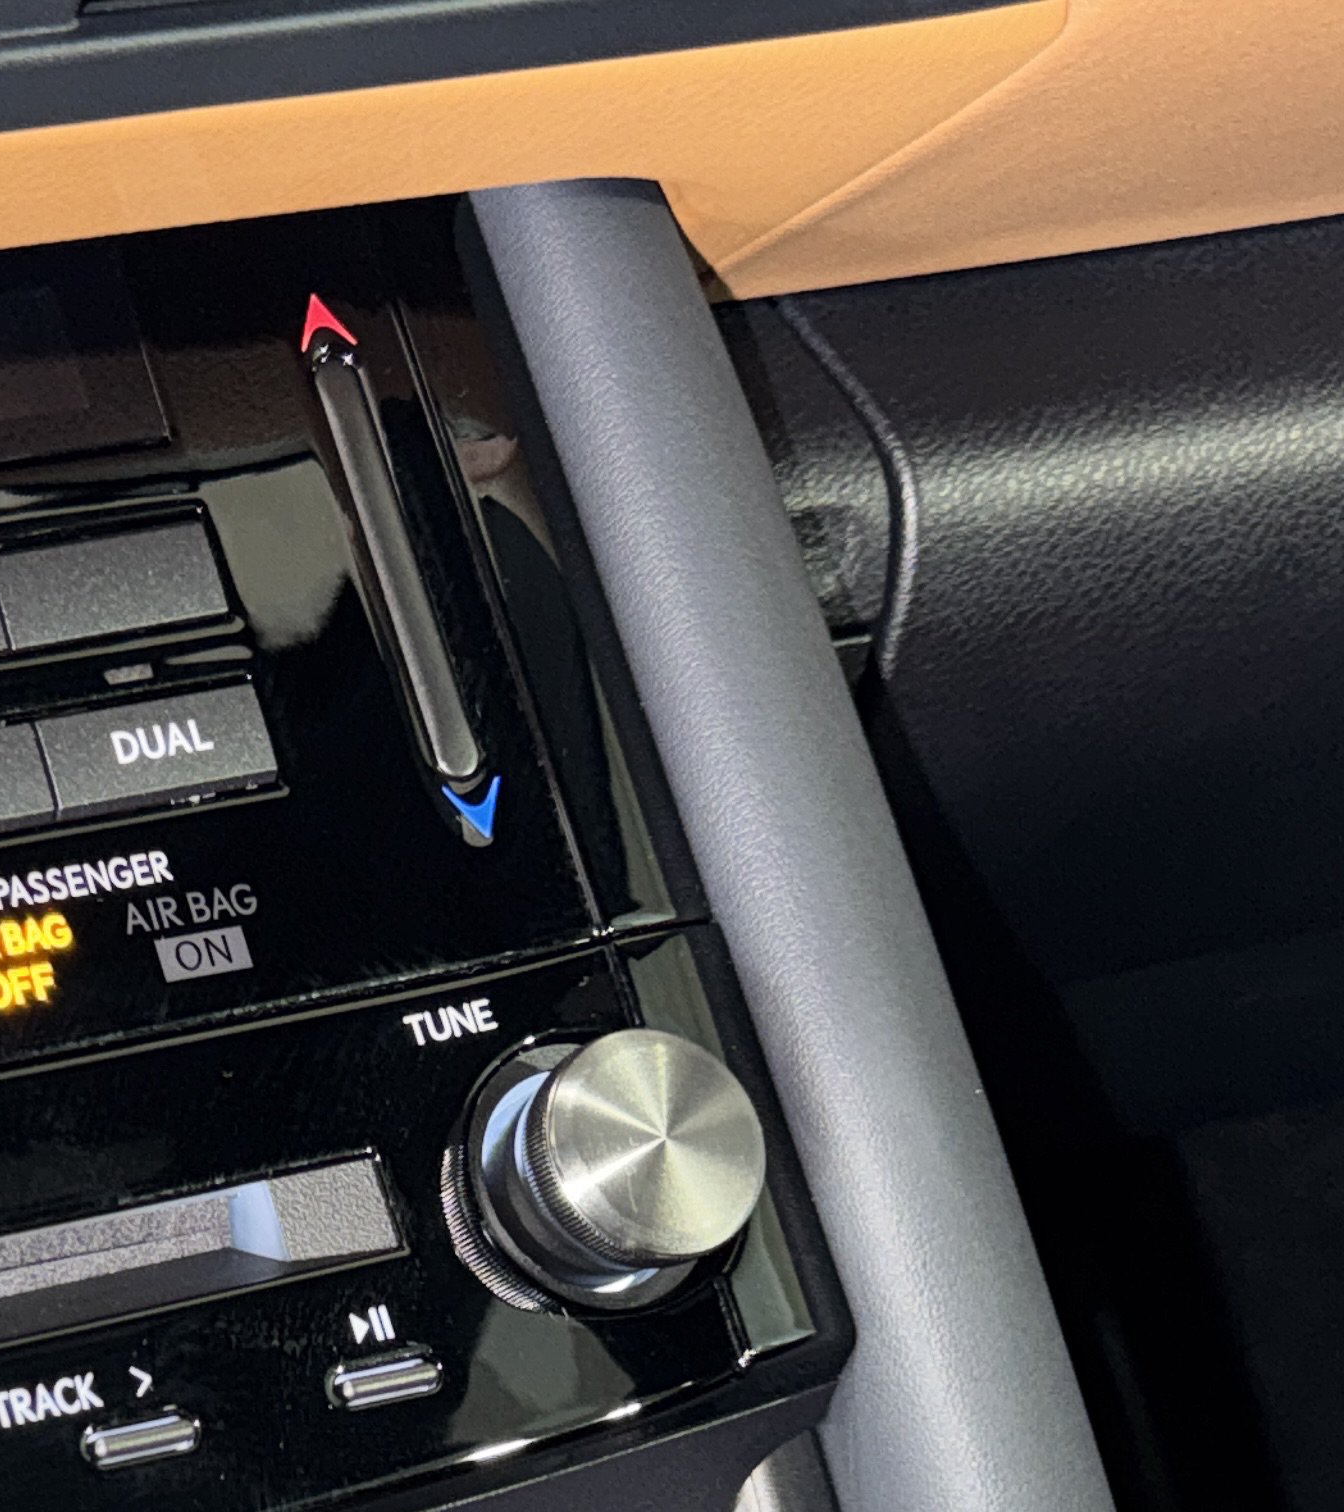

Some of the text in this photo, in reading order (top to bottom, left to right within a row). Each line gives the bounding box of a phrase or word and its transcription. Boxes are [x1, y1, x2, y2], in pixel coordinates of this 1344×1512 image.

[110, 718, 214, 765] DUAL
[126, 883, 258, 936] AIR BAG
[0, 913, 74, 956] BAG
[174, 934, 234, 972] ON
[402, 998, 499, 1046] TUNE
